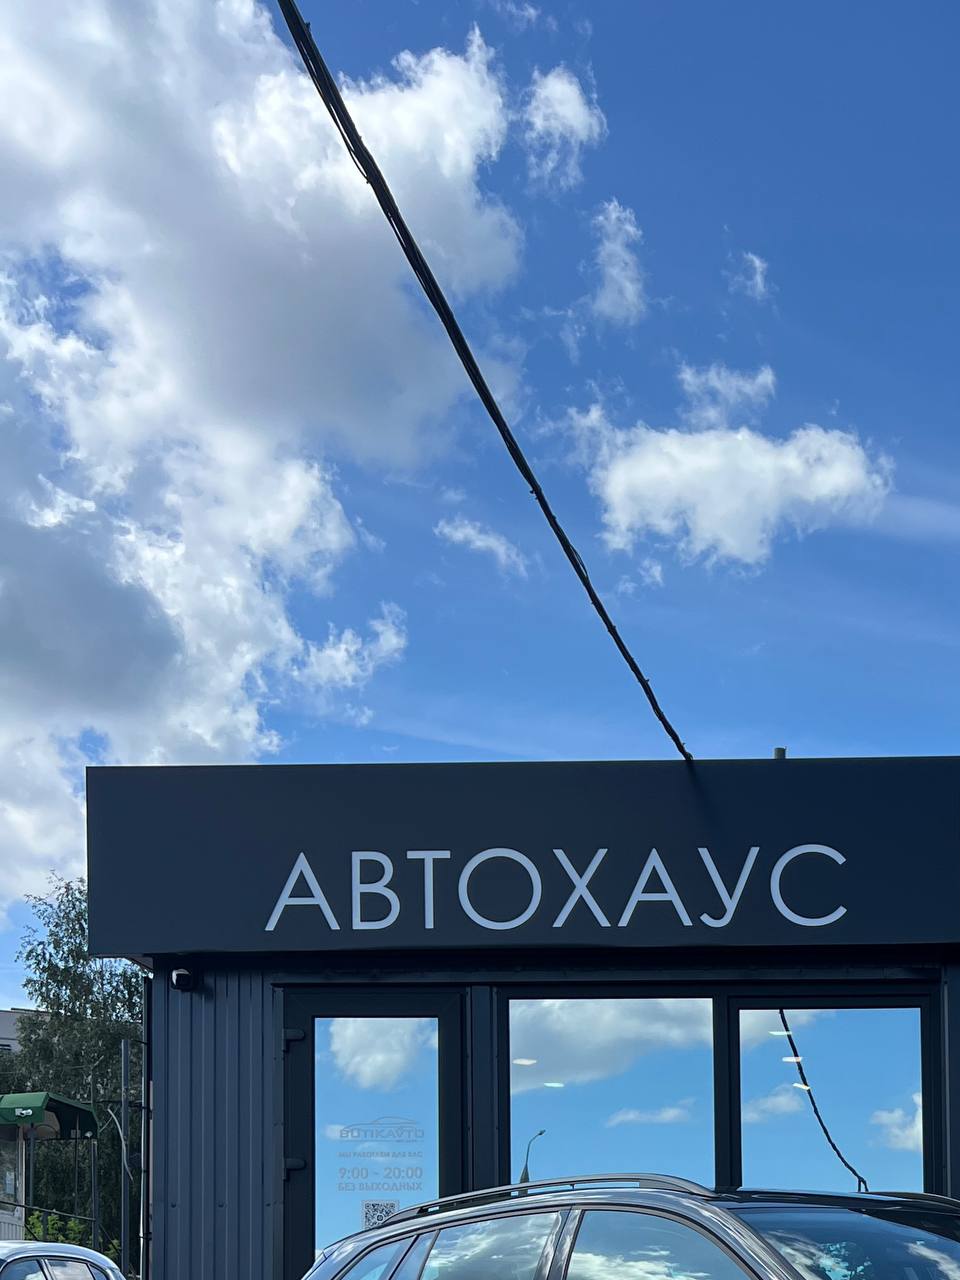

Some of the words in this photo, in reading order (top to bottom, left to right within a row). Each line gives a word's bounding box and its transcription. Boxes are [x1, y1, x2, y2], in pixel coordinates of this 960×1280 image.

[265, 843, 848, 932] АВТОХАУС
[338, 1166, 369, 1180] 9:00
[383, 1166, 424, 1180] 20:00
